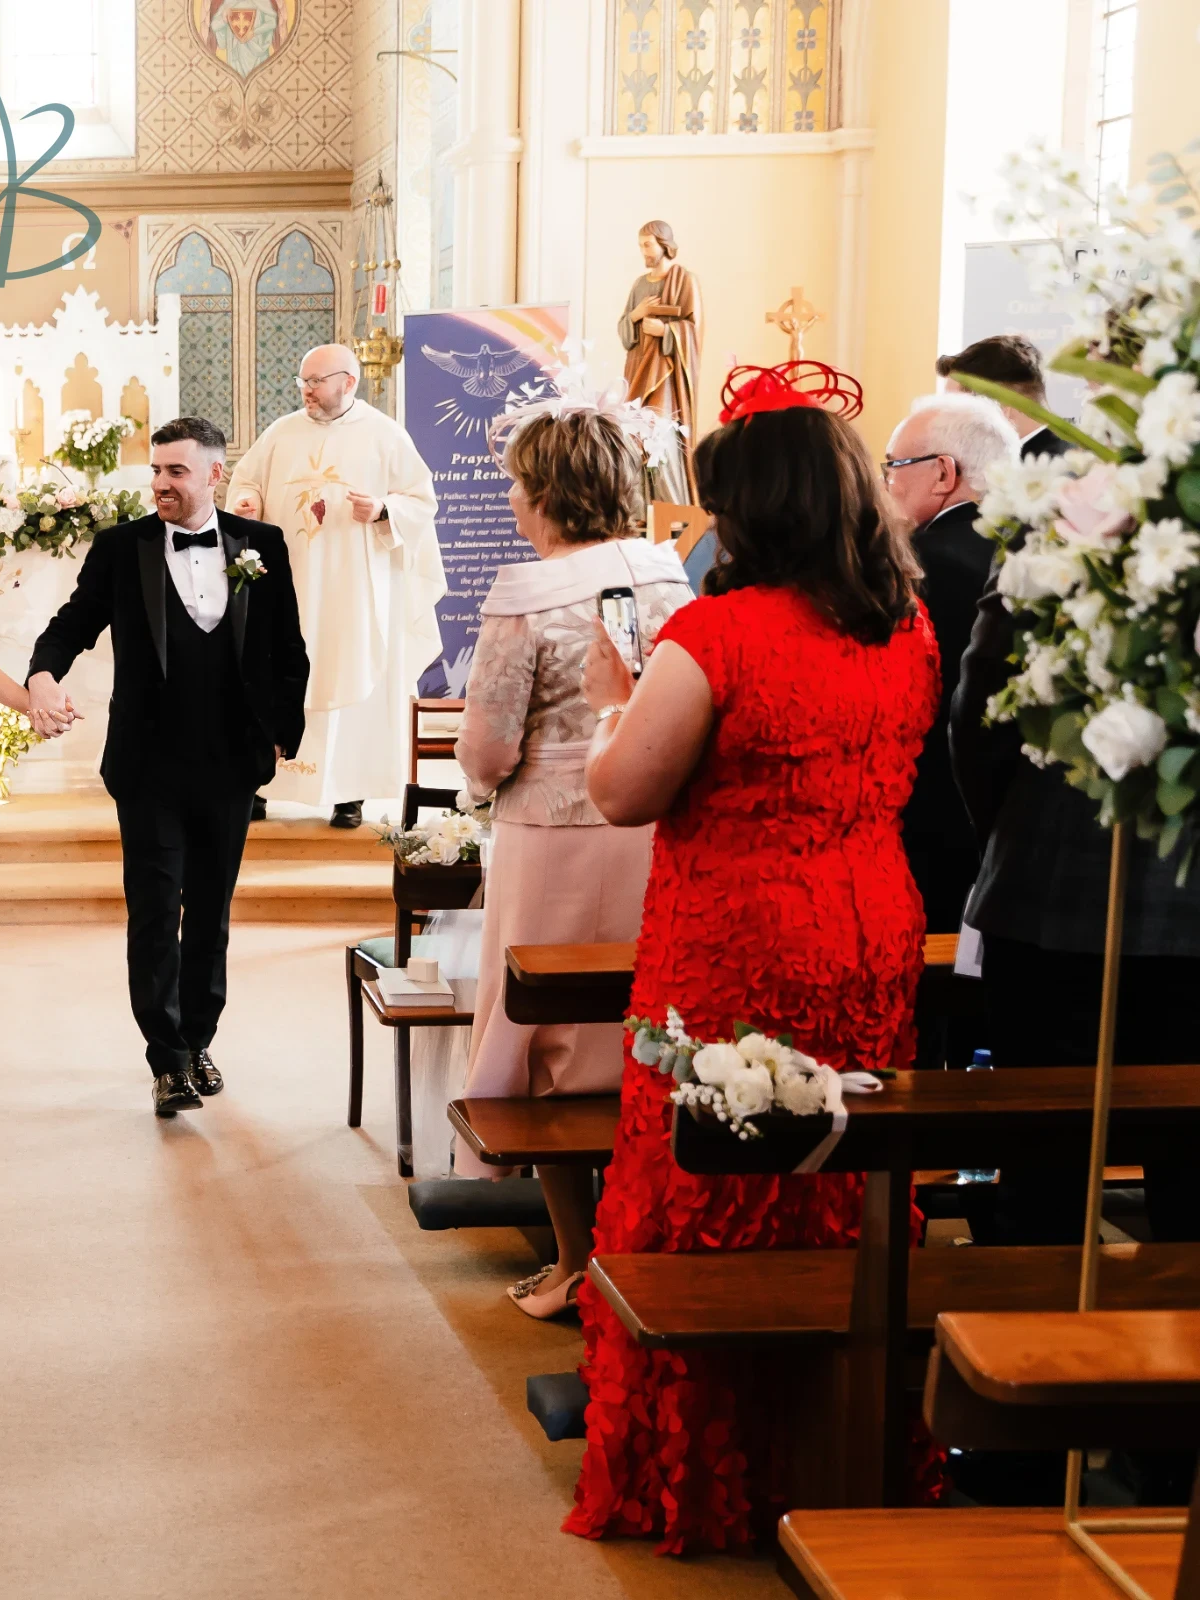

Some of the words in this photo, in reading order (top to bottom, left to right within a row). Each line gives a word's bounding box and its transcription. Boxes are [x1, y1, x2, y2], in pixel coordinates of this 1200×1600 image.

[433, 470, 468, 482] ivine
[473, 468, 507, 480] Reno
[480, 493, 497, 501] pray
[498, 491, 509, 499] tha
[446, 504, 458, 515] for
[459, 504, 483, 512] Divine
[484, 503, 512, 511] Renova
[447, 516, 482, 526] transform
[459, 528, 476, 538] May
[491, 527, 513, 536] vision
[452, 541, 501, 549] Maintenance
[480, 552, 490, 562] by
[491, 551, 503, 560] the
[504, 550, 521, 561] Holy
[456, 564, 467, 573] all
[467, 565, 481, 573] our
[460, 576, 472, 585] the
[472, 576, 485, 586] gift
[474, 589, 488, 597] Jesu
[440, 613, 456, 622] Our
[456, 613, 475, 623] Lady
